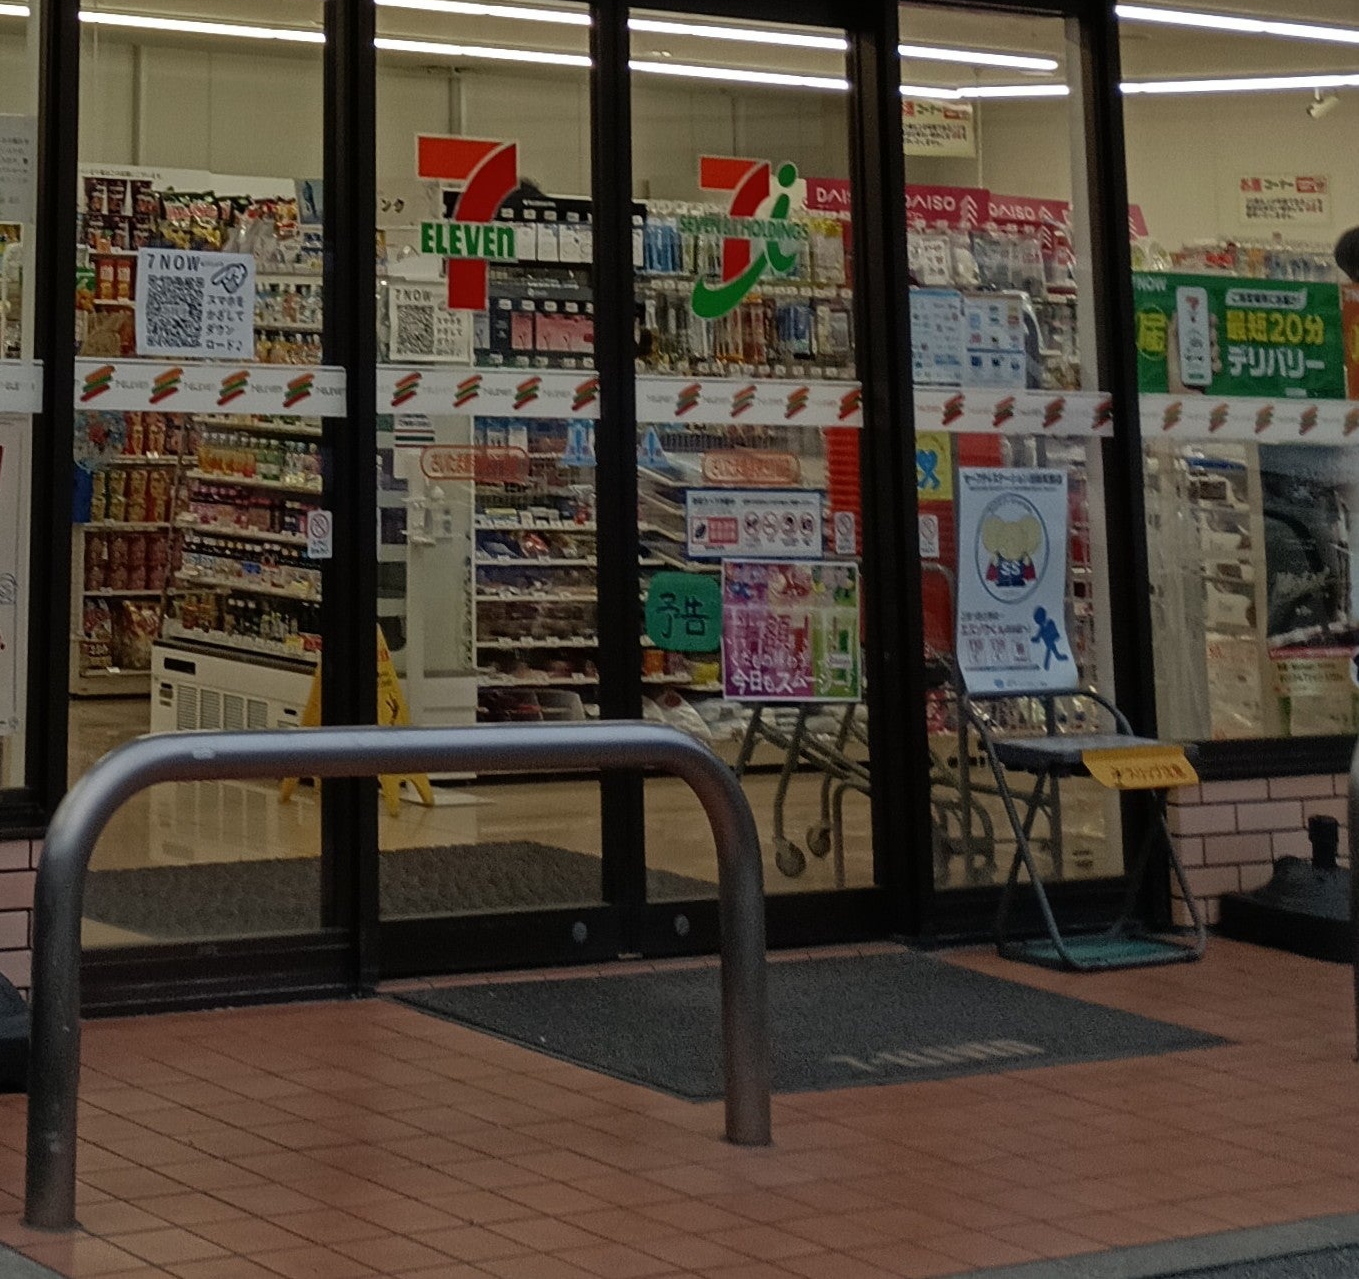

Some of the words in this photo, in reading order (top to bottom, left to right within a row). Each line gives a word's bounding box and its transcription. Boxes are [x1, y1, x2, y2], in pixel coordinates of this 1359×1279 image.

[988, 202, 1036, 221] DAISO
[1225, 308, 1325, 345] 最短20分
[1227, 345, 1326, 379] デリバリー
